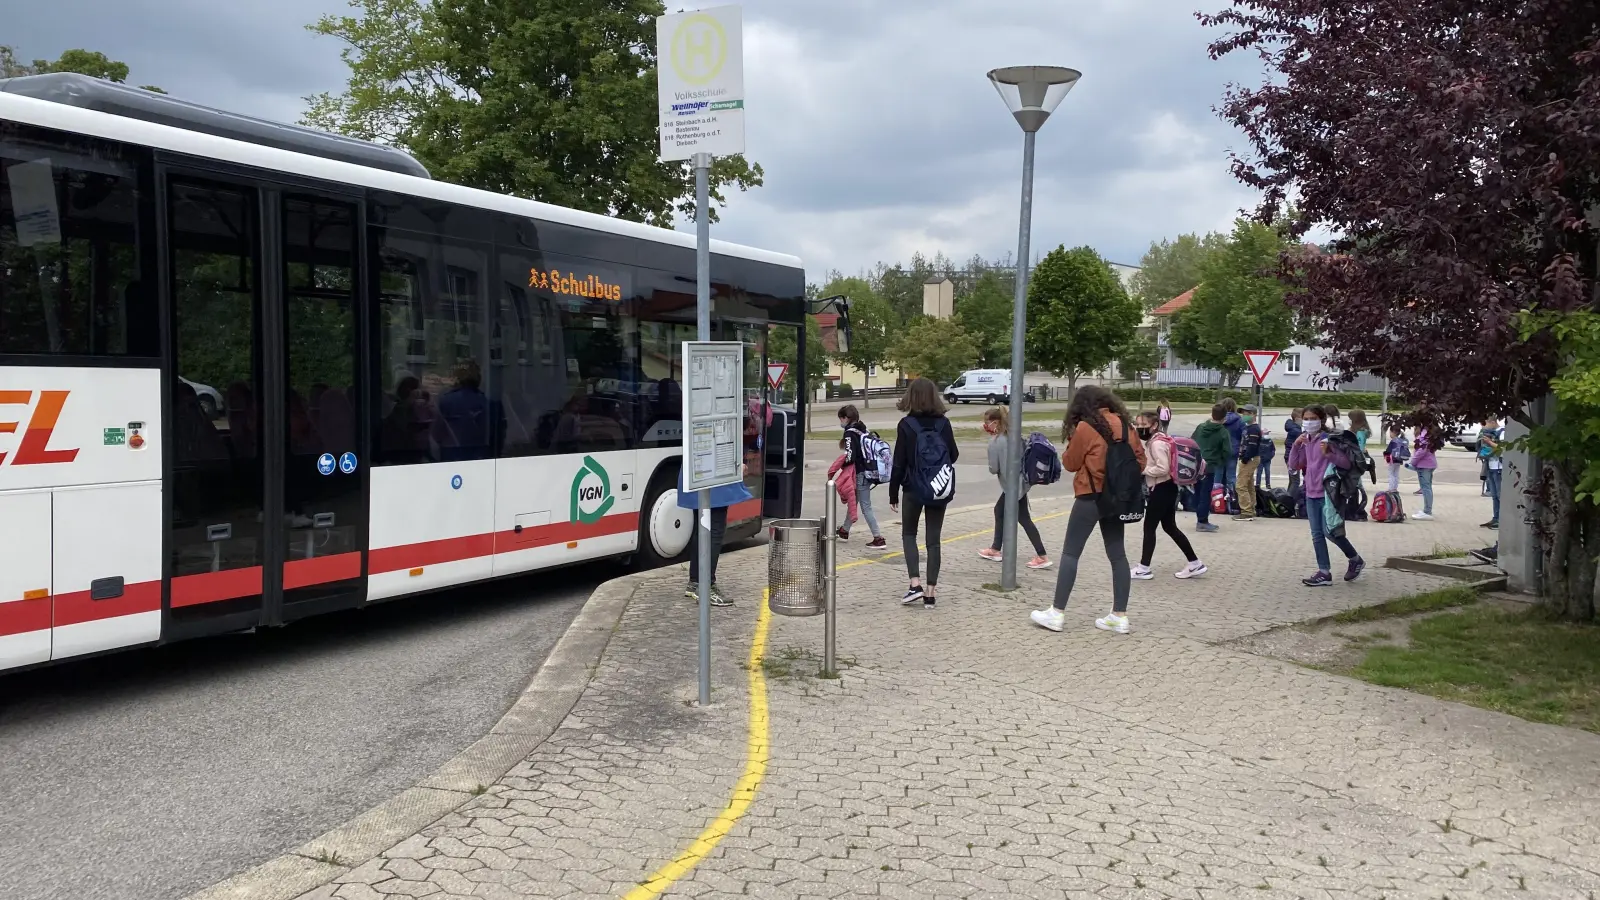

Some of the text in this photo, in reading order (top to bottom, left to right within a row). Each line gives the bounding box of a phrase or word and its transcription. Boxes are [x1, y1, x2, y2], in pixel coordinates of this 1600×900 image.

[685, 30, 711, 70] H
[675, 88, 727, 101] Volksschule
[676, 131, 706, 140] Rothenburg
[550, 269, 621, 301] Schulbus
[930, 463, 951, 495] NIKE
[579, 486, 603, 501] VGN
[1119, 512, 1145, 521] adidas
